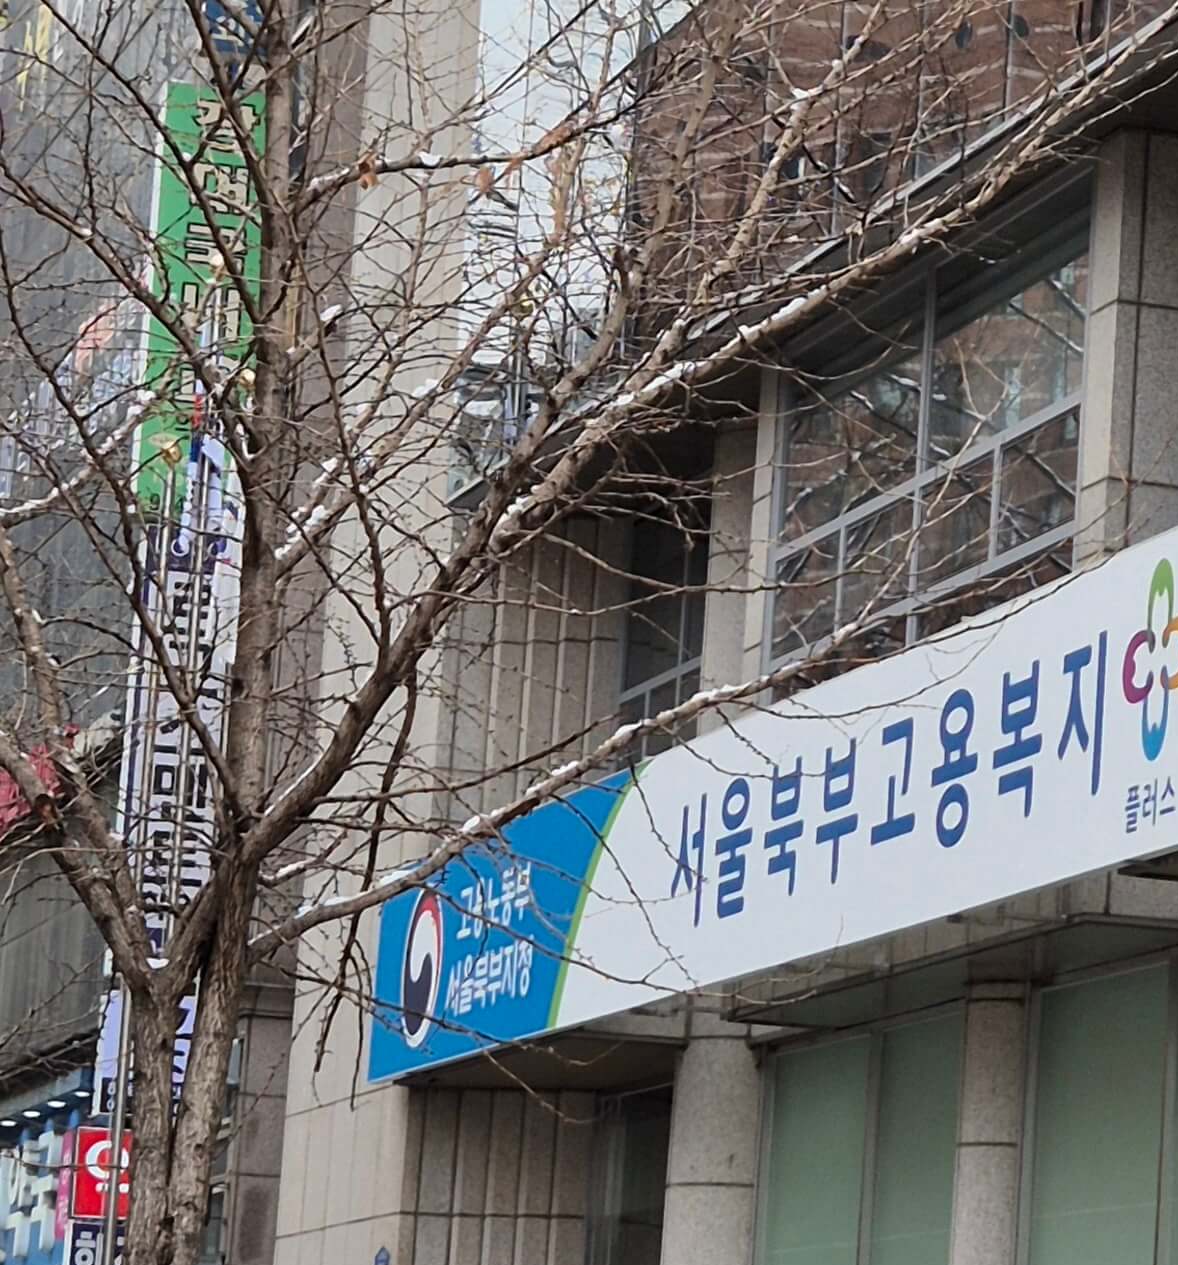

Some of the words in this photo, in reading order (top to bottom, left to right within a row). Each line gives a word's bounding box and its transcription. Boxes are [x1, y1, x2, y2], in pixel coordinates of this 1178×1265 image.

[671, 630, 1108, 928] 서울북부고용복지
[1125, 776, 1176, 834] 플러스
[456, 861, 532, 940] 고용노동부
[445, 934, 535, 1017] 서울북부지청
